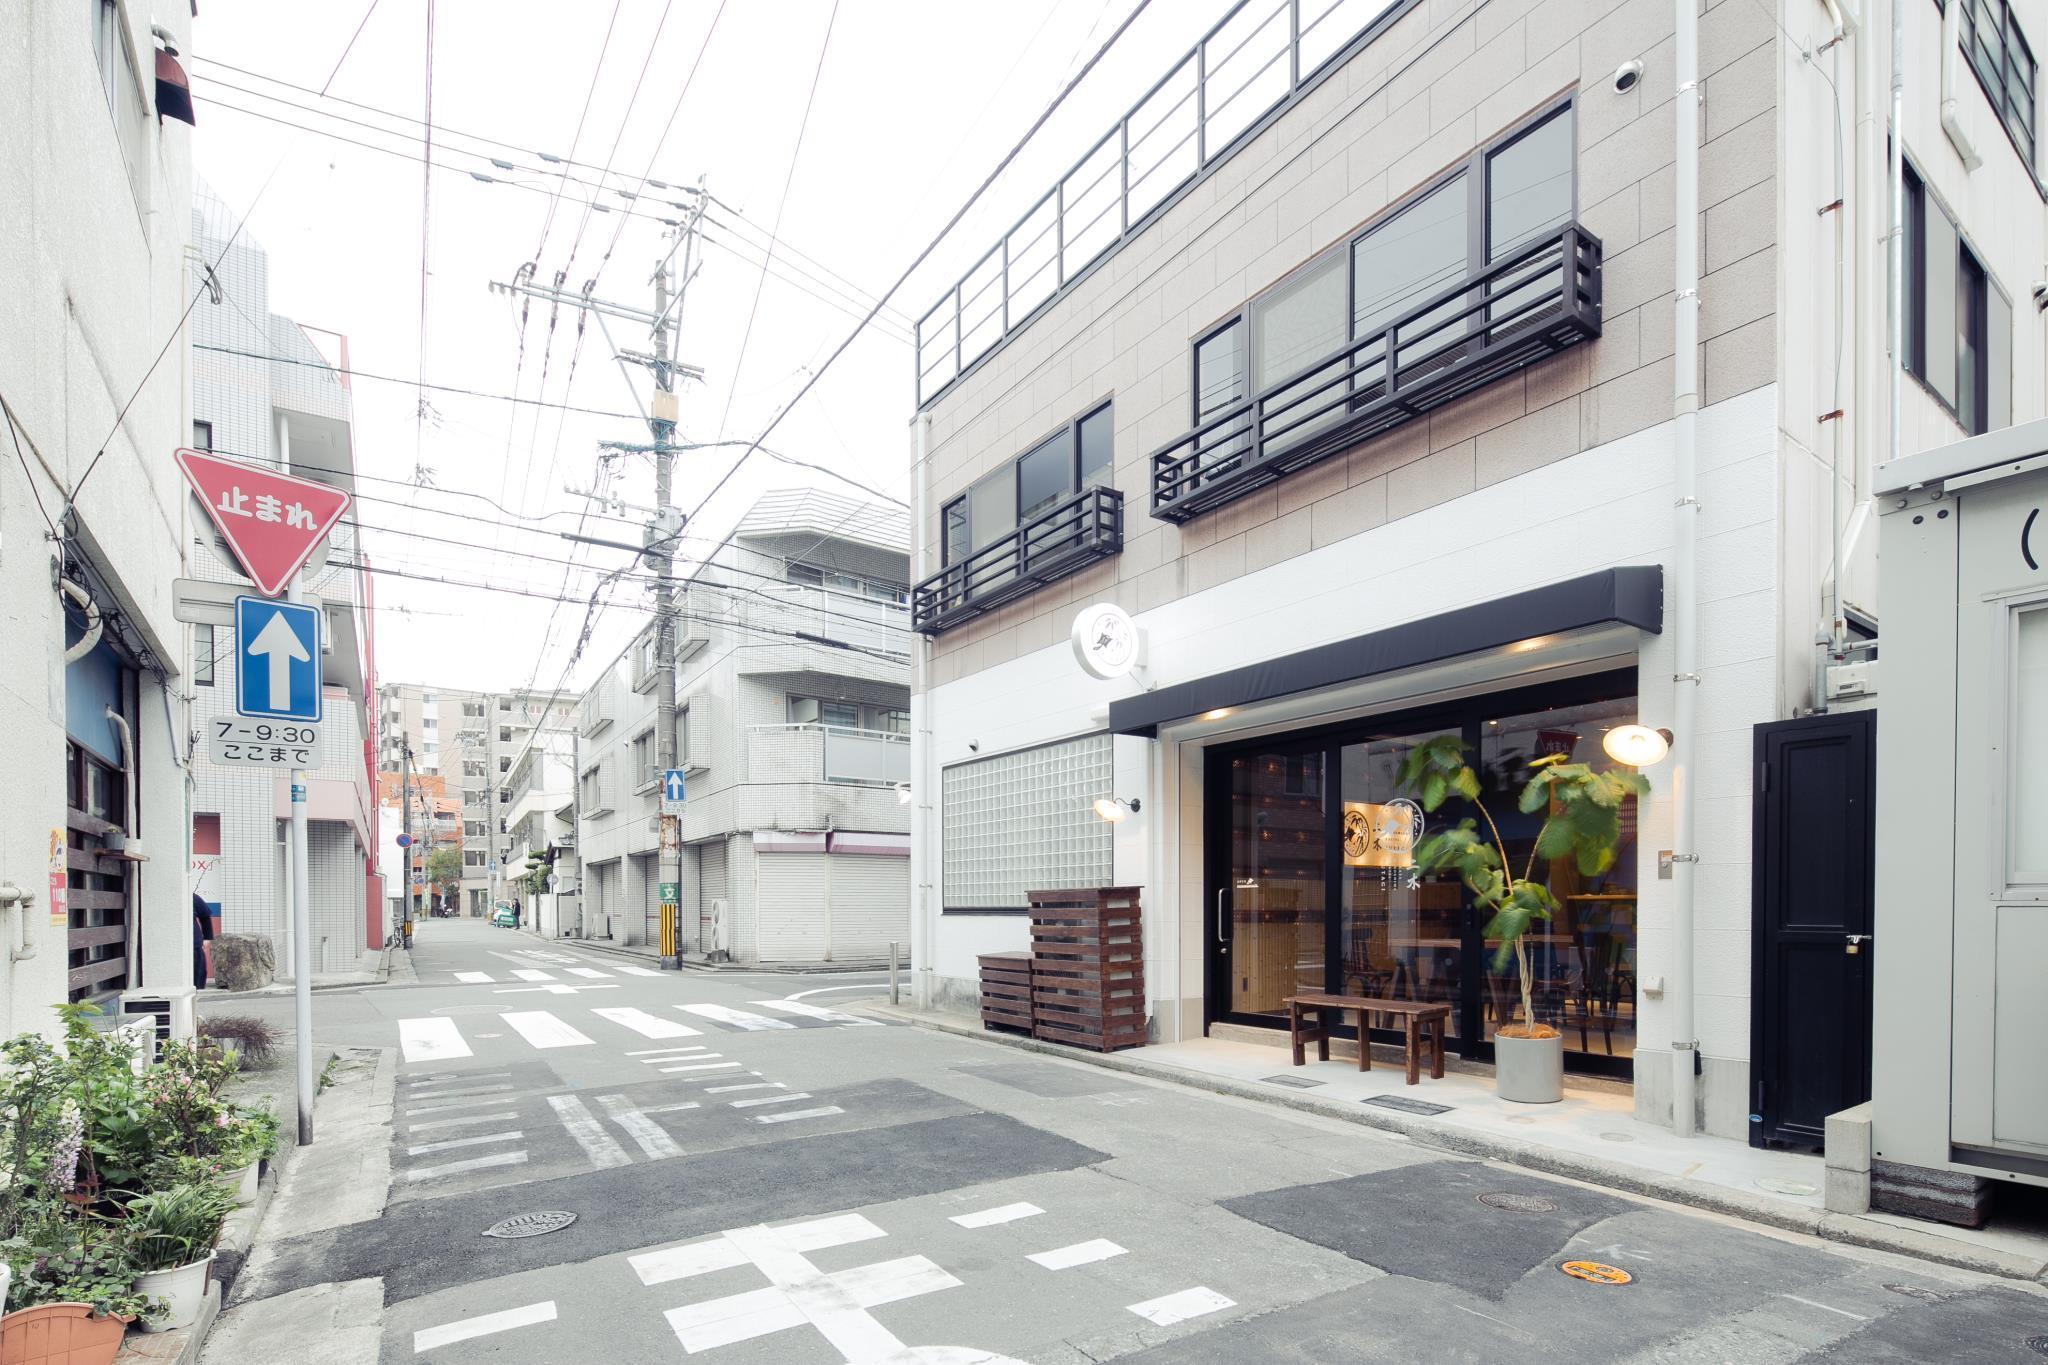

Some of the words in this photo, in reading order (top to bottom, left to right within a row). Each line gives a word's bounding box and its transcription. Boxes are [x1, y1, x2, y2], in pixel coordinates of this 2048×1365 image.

[217, 486, 317, 530] 止まれ
[224, 745, 309, 763] ここまで
